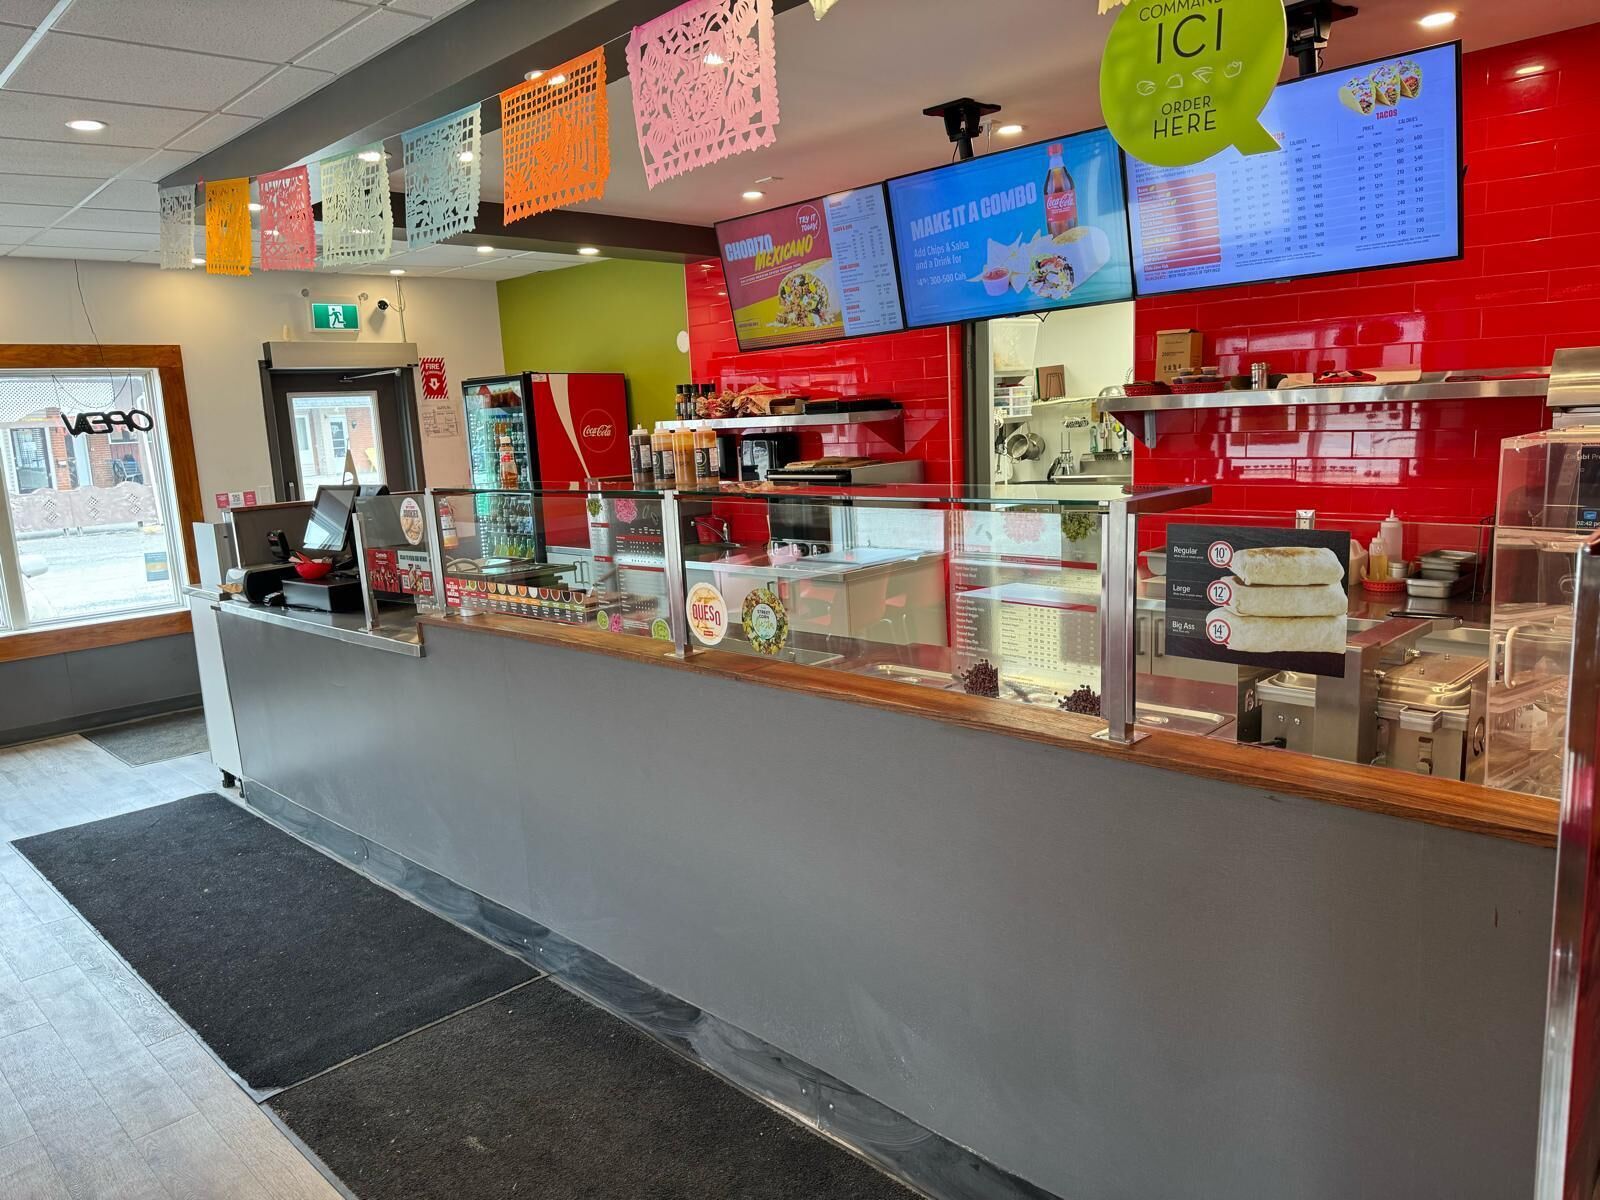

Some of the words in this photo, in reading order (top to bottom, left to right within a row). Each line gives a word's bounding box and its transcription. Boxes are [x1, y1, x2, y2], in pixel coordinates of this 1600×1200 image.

[1156, 8, 1224, 65] ICI
[1161, 95, 1212, 116] ORDER
[1375, 108, 1398, 121] TACOS
[1153, 109, 1217, 140] HERE
[1046, 194, 1074, 210] Coca-Cola
[799, 216, 809, 224] TRY
[810, 213, 816, 222] IT
[910, 209, 952, 241] MAKE
[952, 204, 966, 228] IT
[968, 200, 980, 223] A
[980, 181, 1037, 219] COMBO
[725, 234, 773, 262] CHORIZO
[755, 234, 813, 272] MEXICANO
[914, 247, 927, 257] Add
[927, 244, 945, 256] Chips
[945, 242, 950, 252] &
[951, 240, 970, 251] Salsa
[915, 260, 928, 271] and
[933, 255, 951, 267] Drink
[952, 254, 962, 264] for
[954, 271, 967, 281] Cals
[583, 424, 613, 437] Coca-Cola
[1173, 545, 1198, 555] Regular
[1172, 583, 1191, 593] Large
[692, 603, 721, 626] QUESO
[1172, 620, 1182, 630] Big
[1183, 621, 1196, 630] Ass
